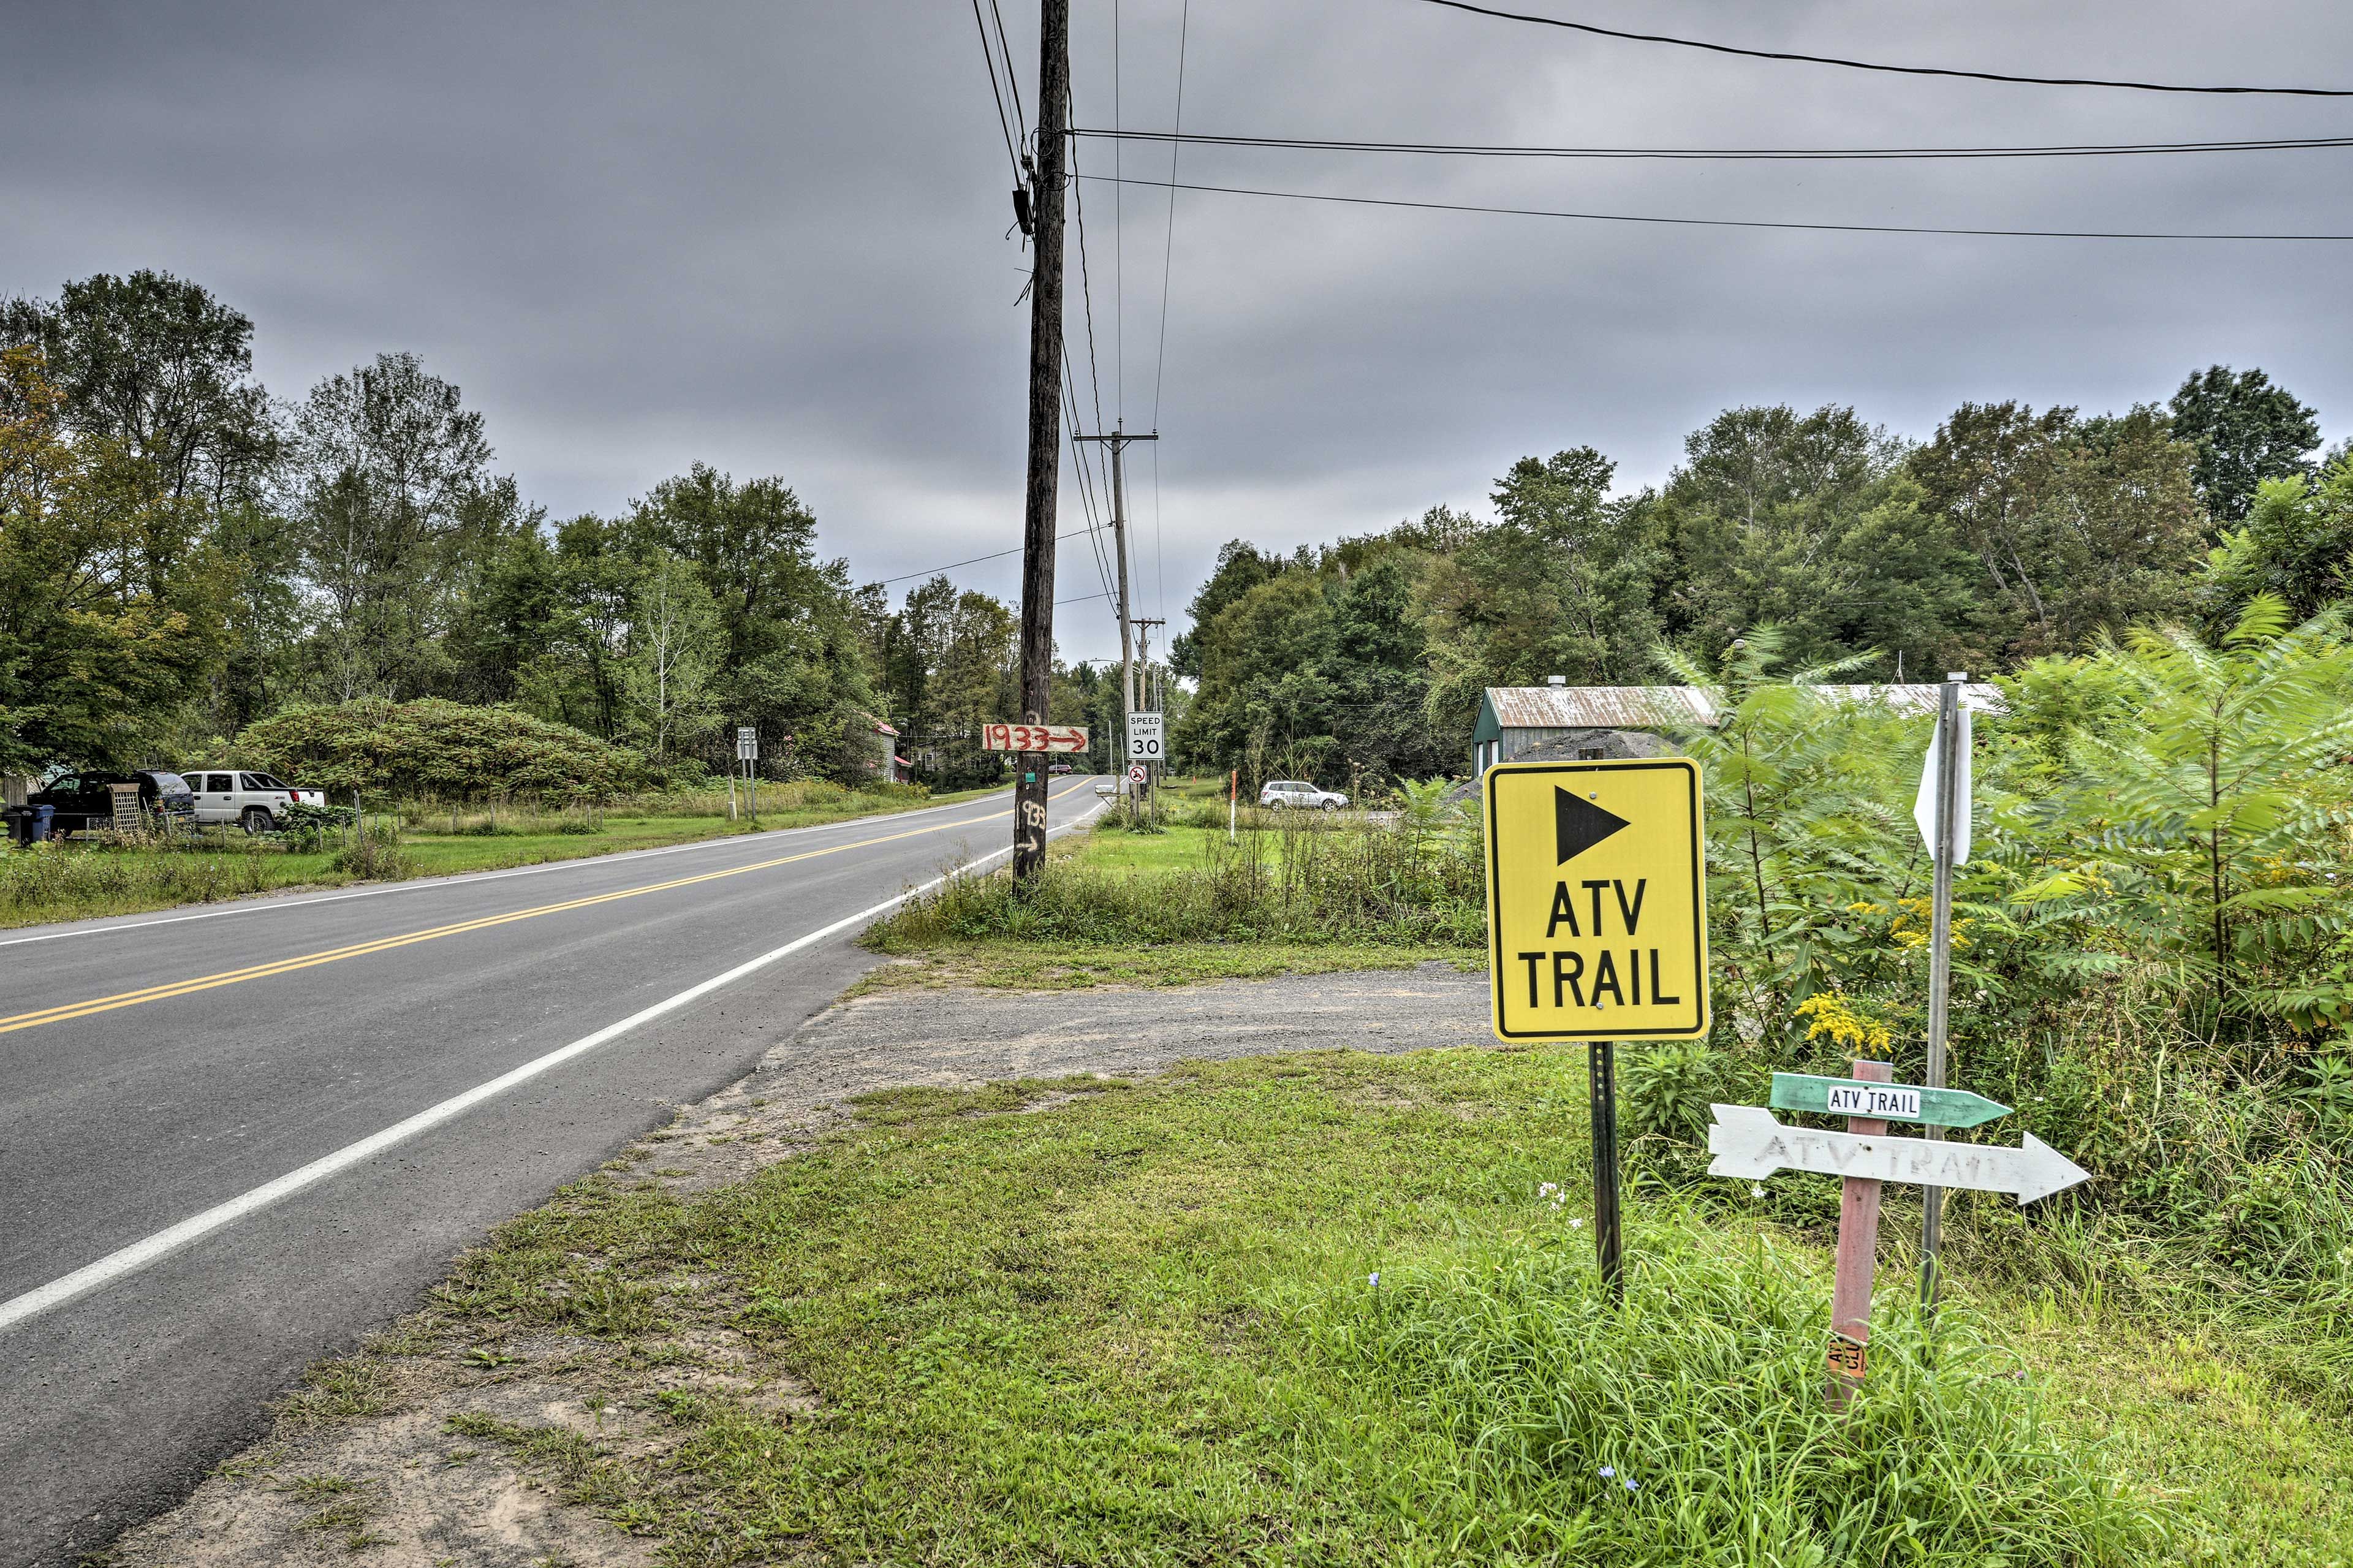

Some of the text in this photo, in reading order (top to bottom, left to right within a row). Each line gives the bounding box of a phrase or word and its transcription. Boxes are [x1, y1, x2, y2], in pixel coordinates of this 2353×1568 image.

[985, 724, 1050, 751] 1933
[1132, 740, 1159, 754] 30
[1546, 878, 1646, 938] ATV
[1518, 949, 1680, 1009] TRAIL
[1830, 1089, 1917, 1113] ATV TRAIL
[1754, 1135, 1859, 1169] ATV
